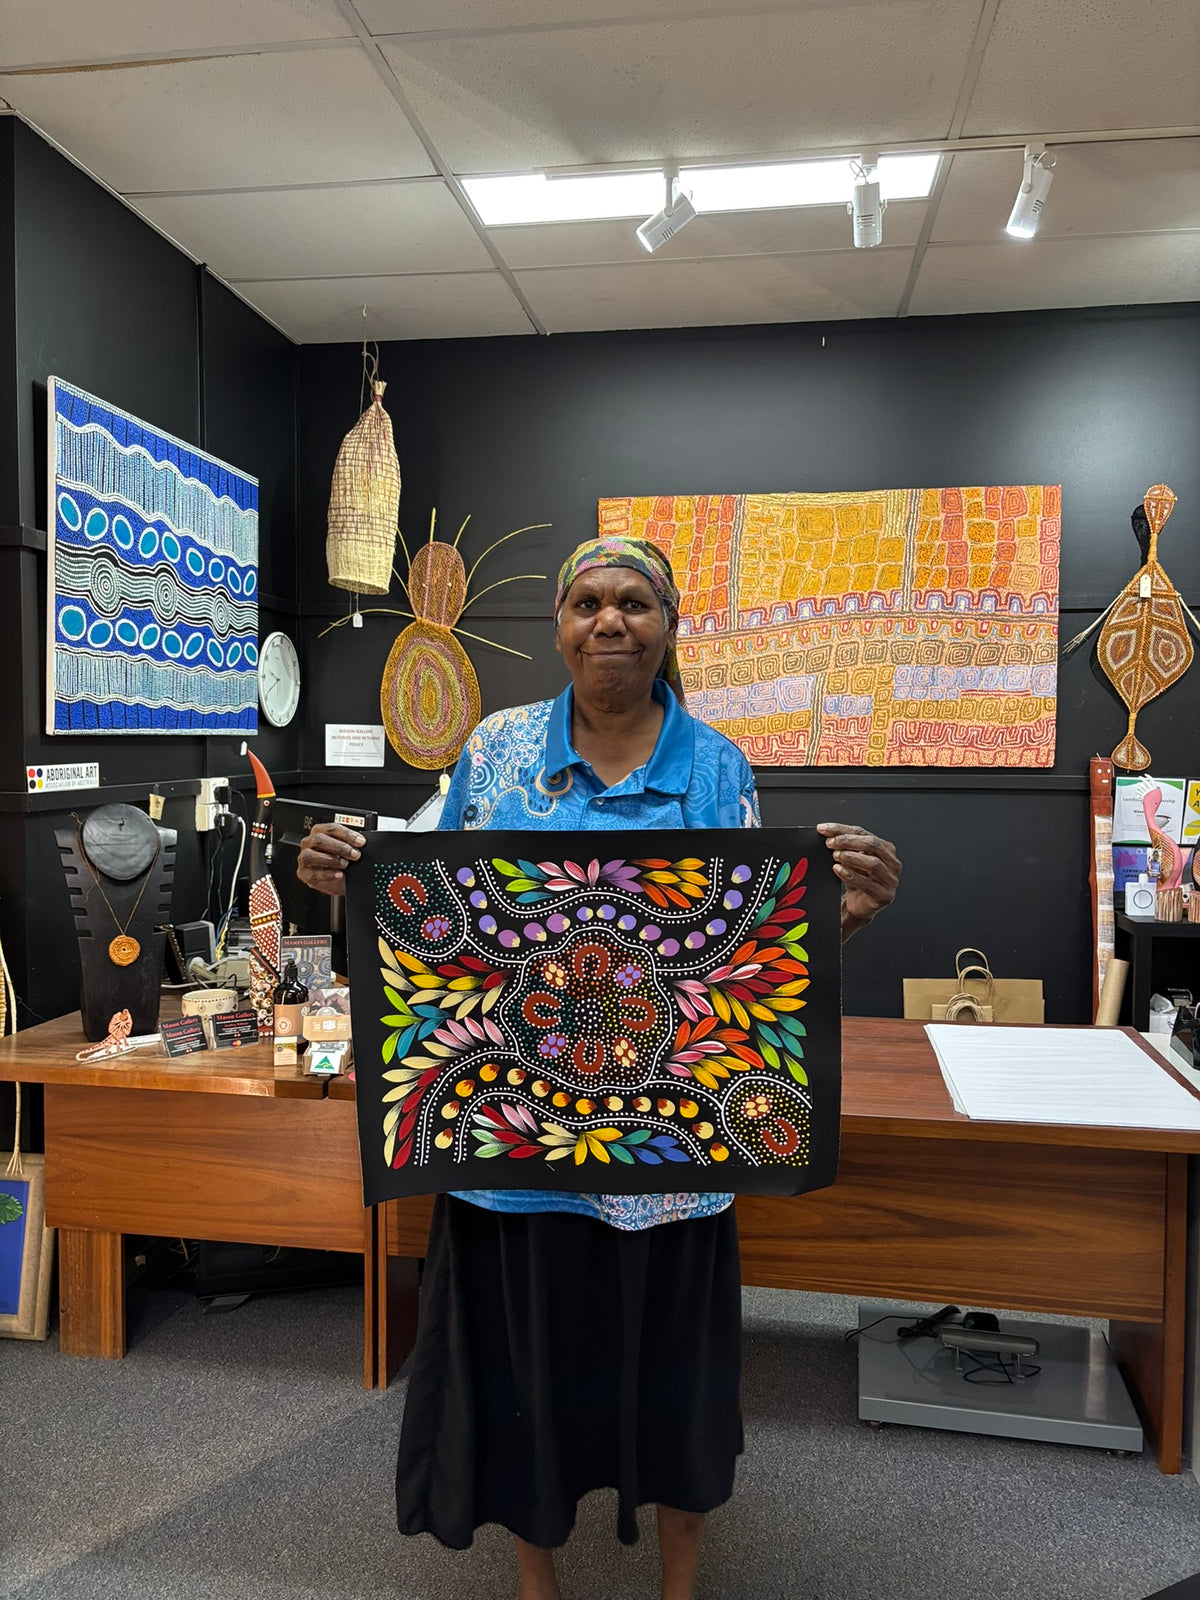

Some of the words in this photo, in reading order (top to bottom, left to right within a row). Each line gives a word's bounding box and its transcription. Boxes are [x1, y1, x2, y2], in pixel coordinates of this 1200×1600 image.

[46, 766, 84, 782] ABORIGINAL
[85, 765, 97, 779] ART
[216, 1013, 235, 1021] Mason
[235, 1011, 255, 1019] Gallery
[162, 1022, 180, 1030] Mason
[180, 1018, 198, 1026] Gallery
[165, 1031, 183, 1039] Mason
[182, 1027, 201, 1036] Gallery
